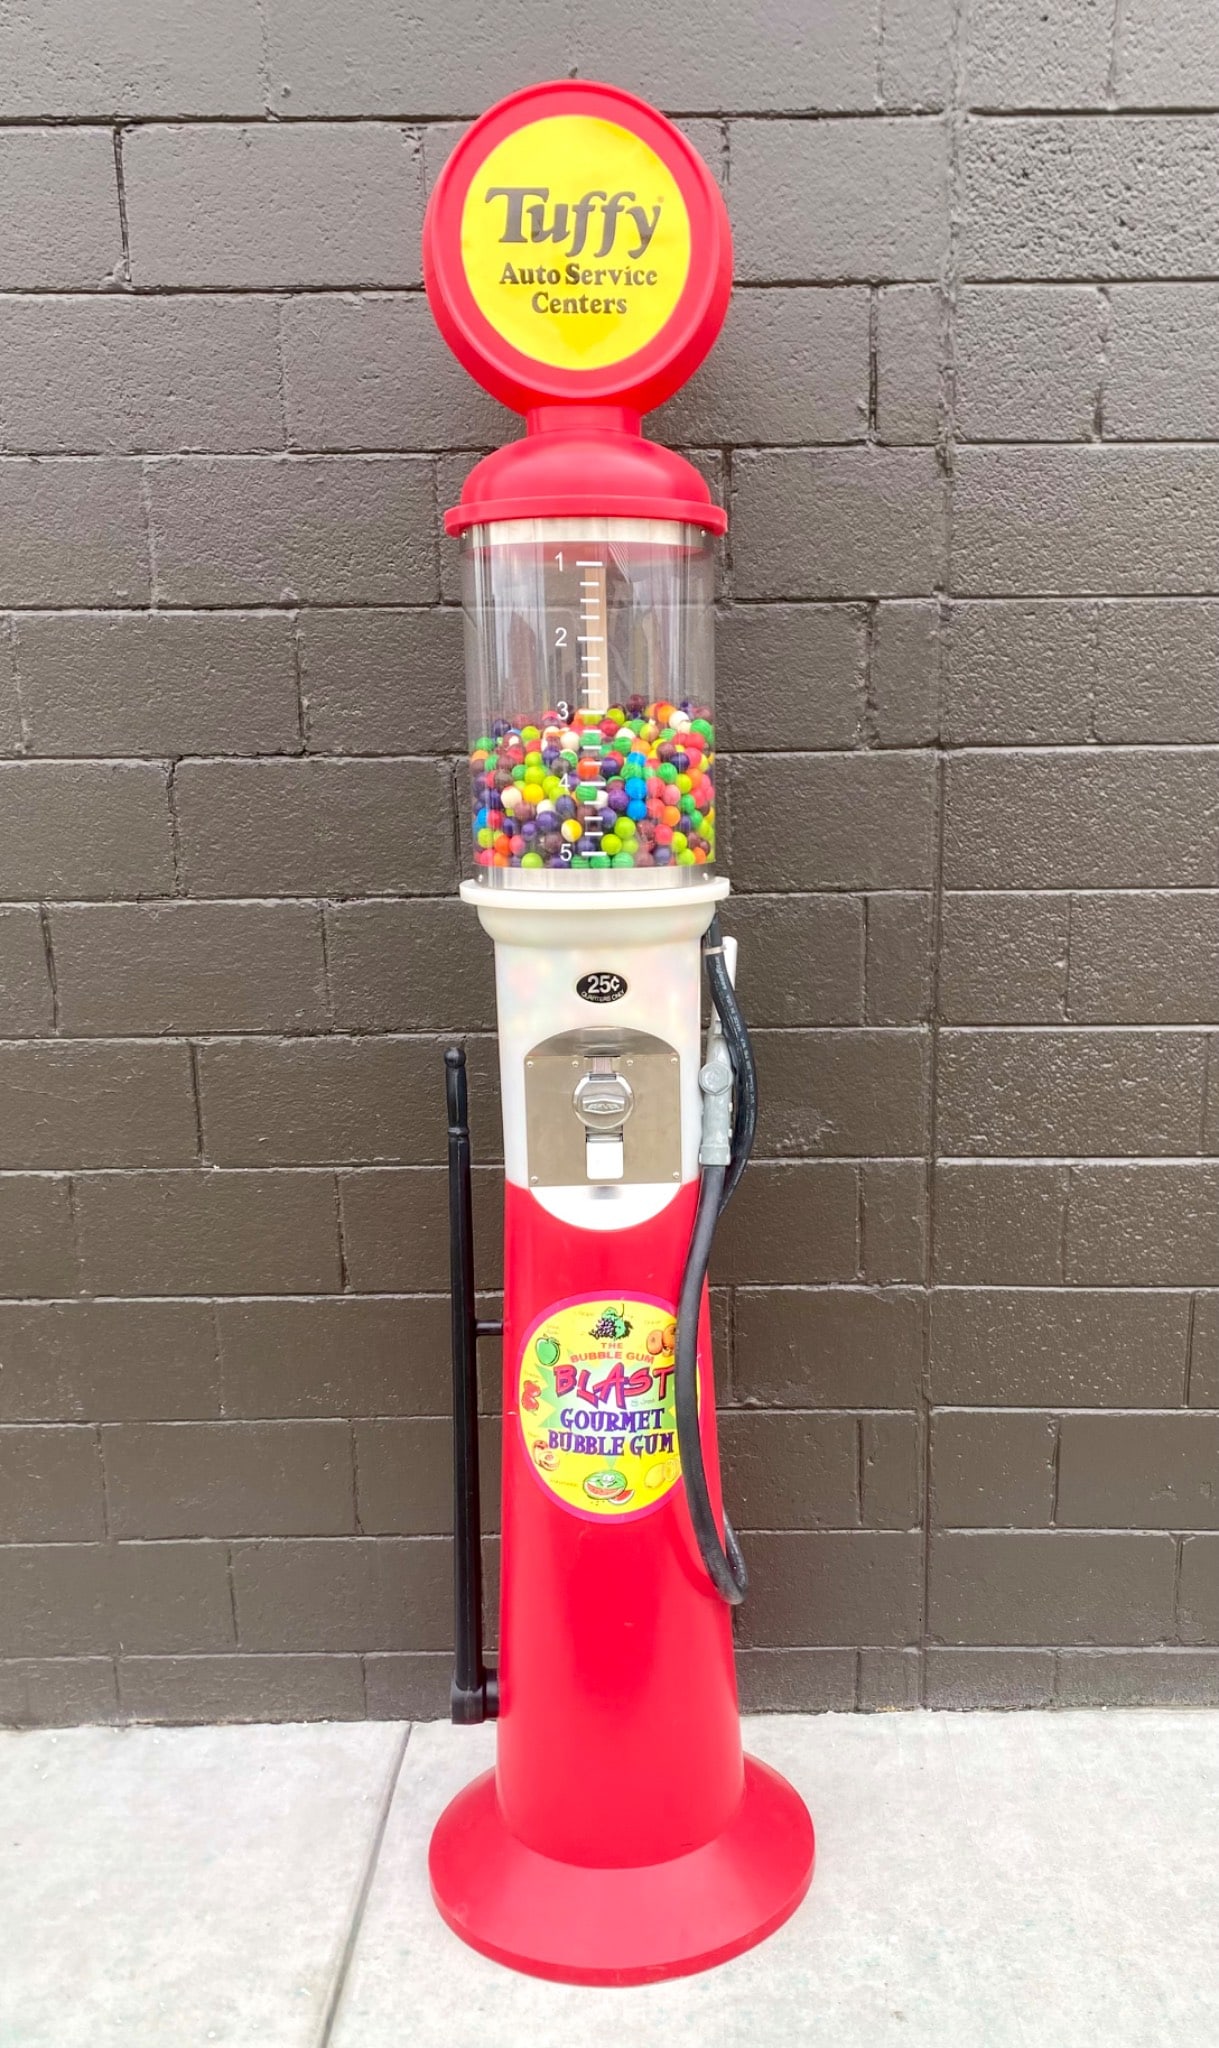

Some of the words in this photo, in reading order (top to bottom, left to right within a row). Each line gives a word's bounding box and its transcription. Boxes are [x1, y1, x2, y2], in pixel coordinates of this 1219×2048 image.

[485, 187, 662, 259] Tuffy
[499, 262, 561, 285] Auto
[565, 263, 658, 286] Service
[532, 291, 627, 314] Centers
[554, 551, 564, 572] 1
[555, 627, 567, 647] 2
[556, 701, 569, 721] 3
[559, 769, 571, 789] 4
[560, 843, 572, 862] 5
[587, 974, 620, 994] 25¢
[570, 1351, 622, 1364] BUBBLE
[626, 1352, 655, 1364] GUM
[553, 1362, 676, 1409] BLAST
[560, 1407, 665, 1433] GOURMET
[548, 1429, 625, 1456] BUBBLE
[629, 1432, 674, 1460] GUM
